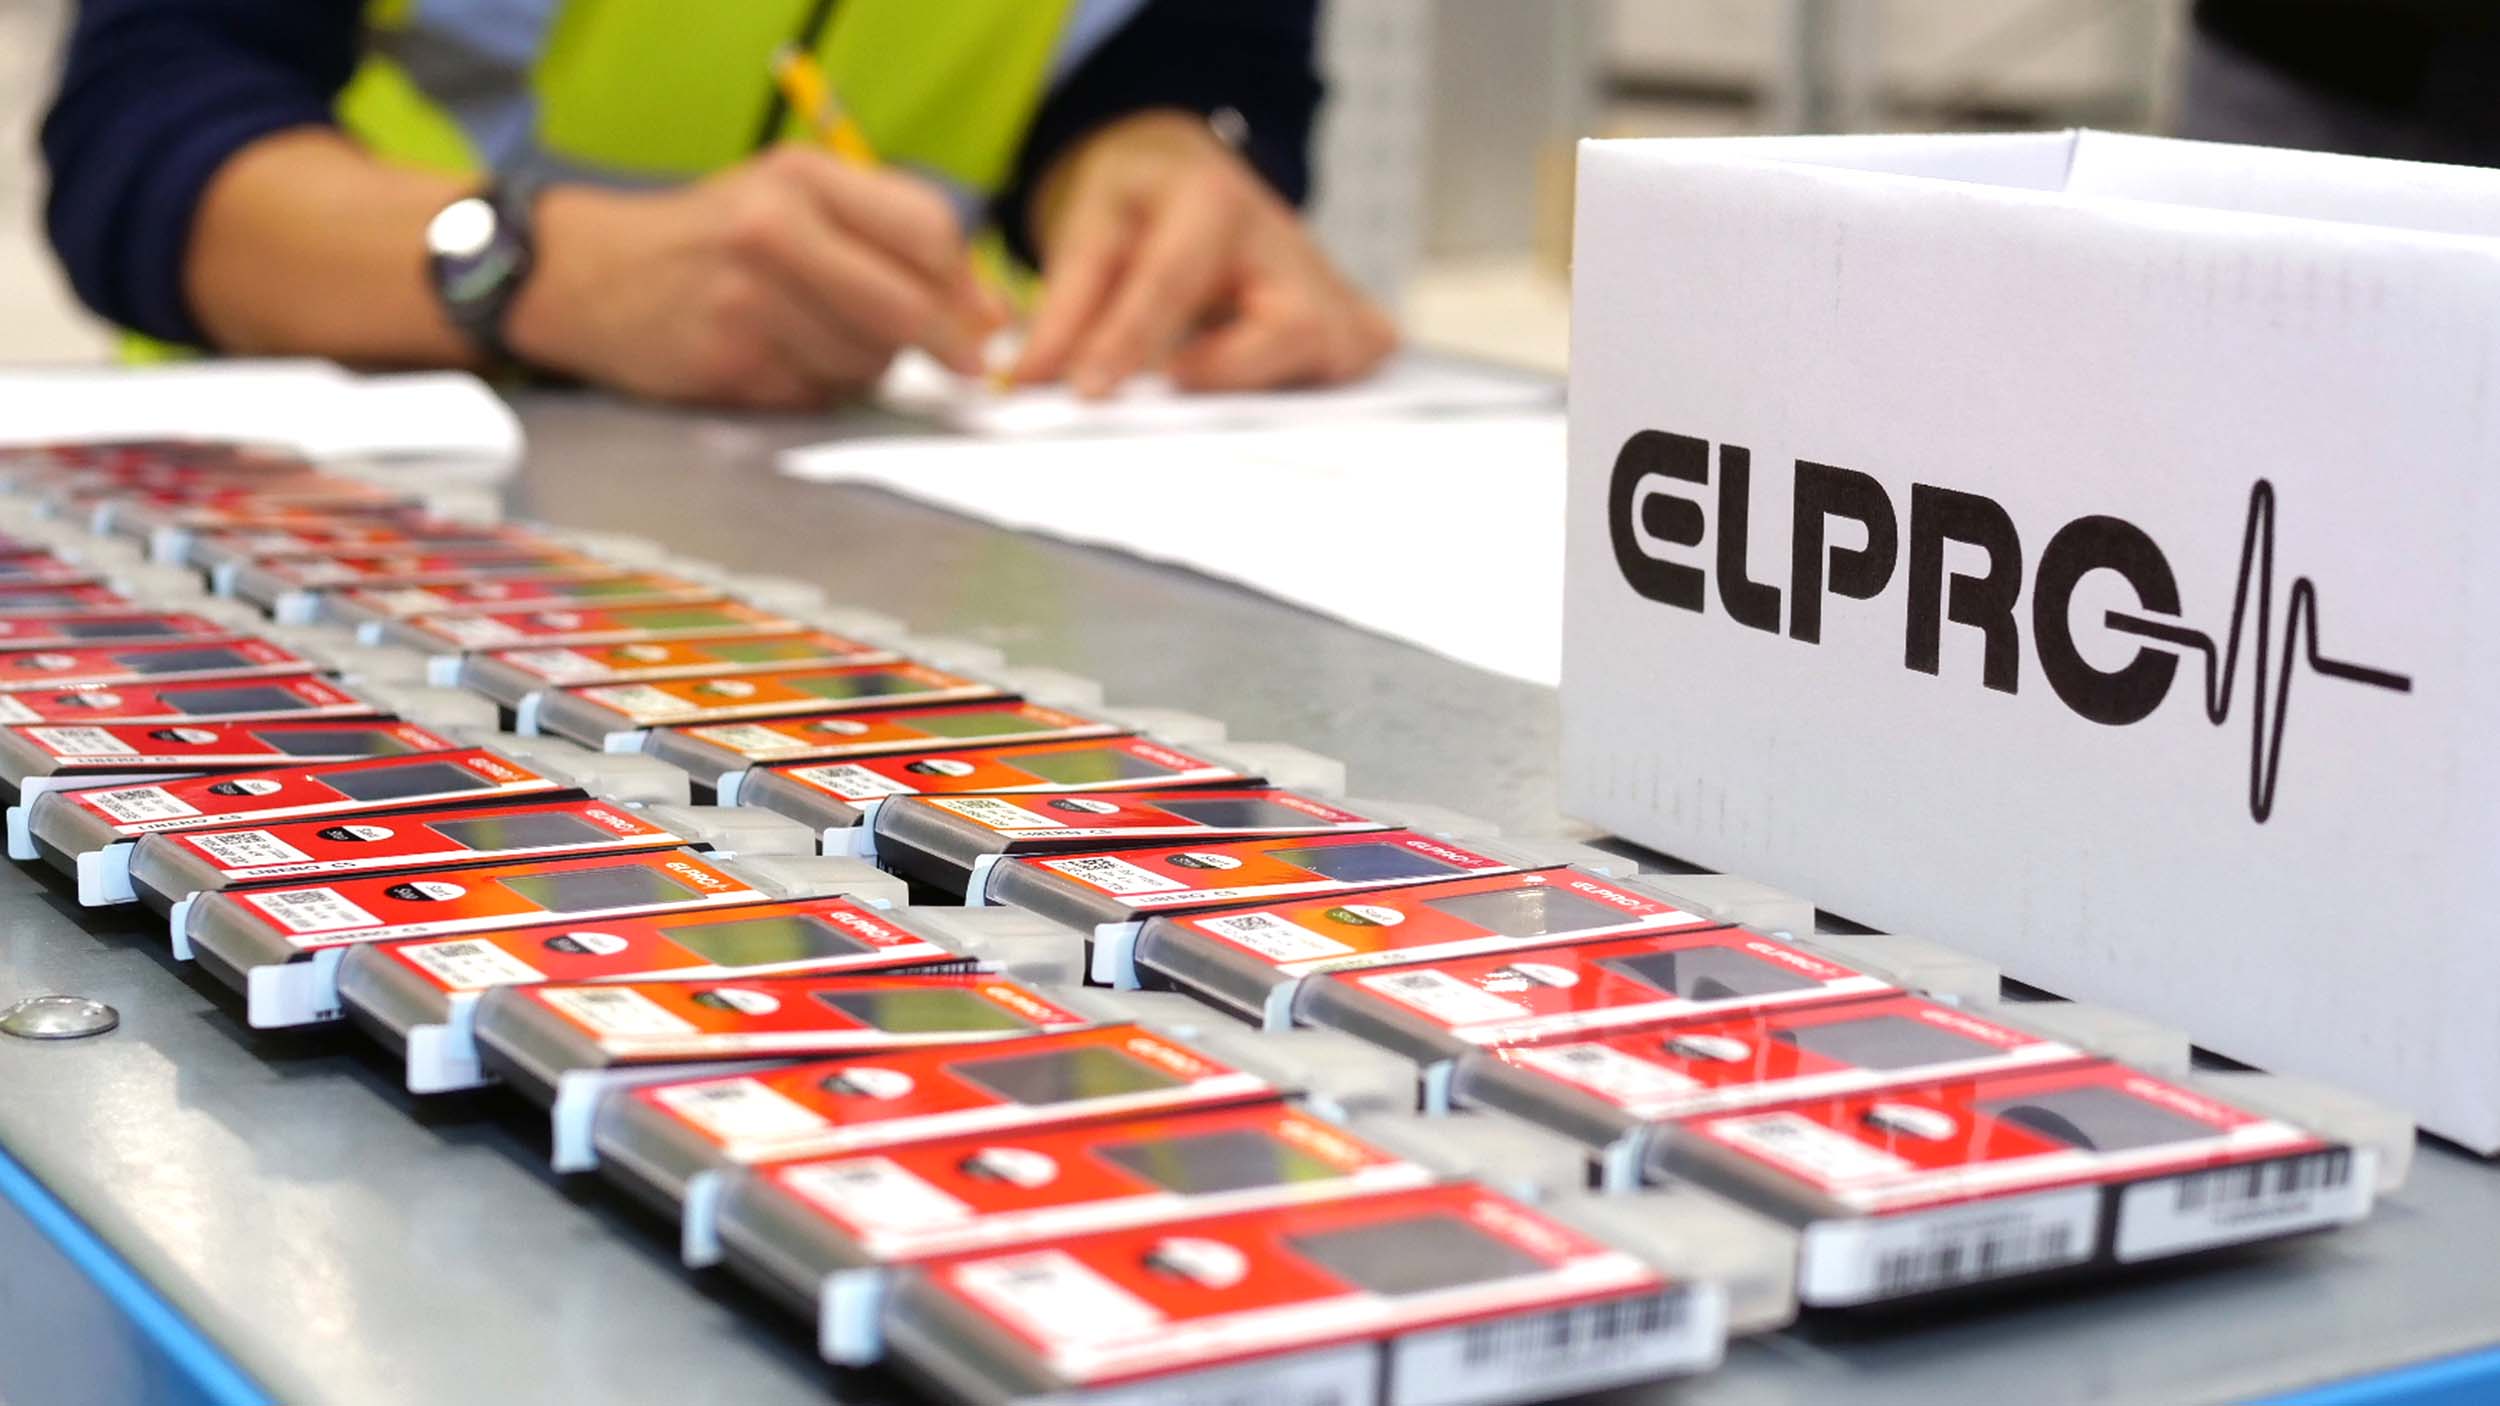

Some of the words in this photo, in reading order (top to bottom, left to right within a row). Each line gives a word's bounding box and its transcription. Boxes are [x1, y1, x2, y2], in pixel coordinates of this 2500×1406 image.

[1608, 428, 2182, 727] ELPRO
[1405, 840, 1470, 863] ELPRO
[664, 861, 720, 885] ELPRO
[1570, 881, 1641, 907] ELPRO
[830, 911, 891, 938] ELPRO
